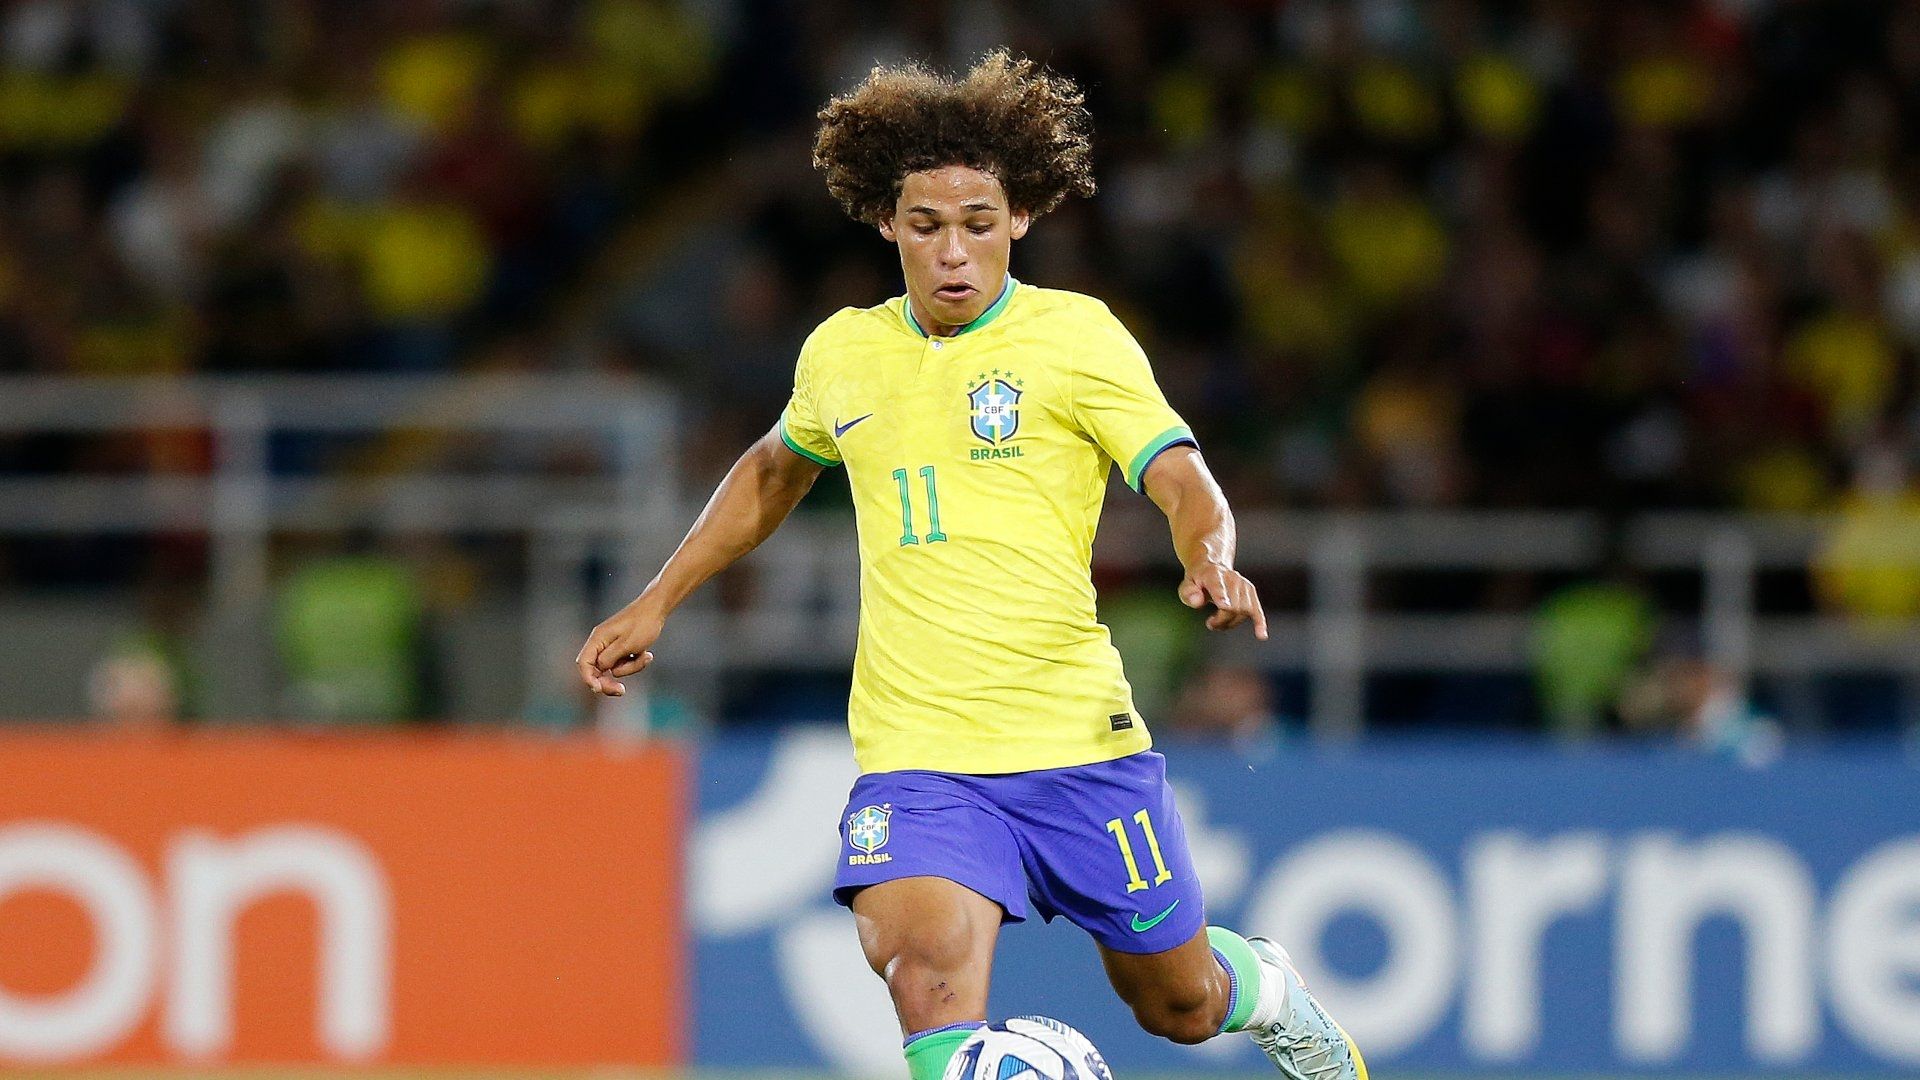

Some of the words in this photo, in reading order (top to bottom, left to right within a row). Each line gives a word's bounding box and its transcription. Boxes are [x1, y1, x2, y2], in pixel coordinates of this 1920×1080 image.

[984, 405, 1004, 414] CBF
[970, 446, 1024, 460] BRASIL
[892, 465, 947, 547] 11
[848, 853, 893, 866] BRASIL
[1105, 807, 1173, 894] 11
[0, 824, 390, 1058] on
